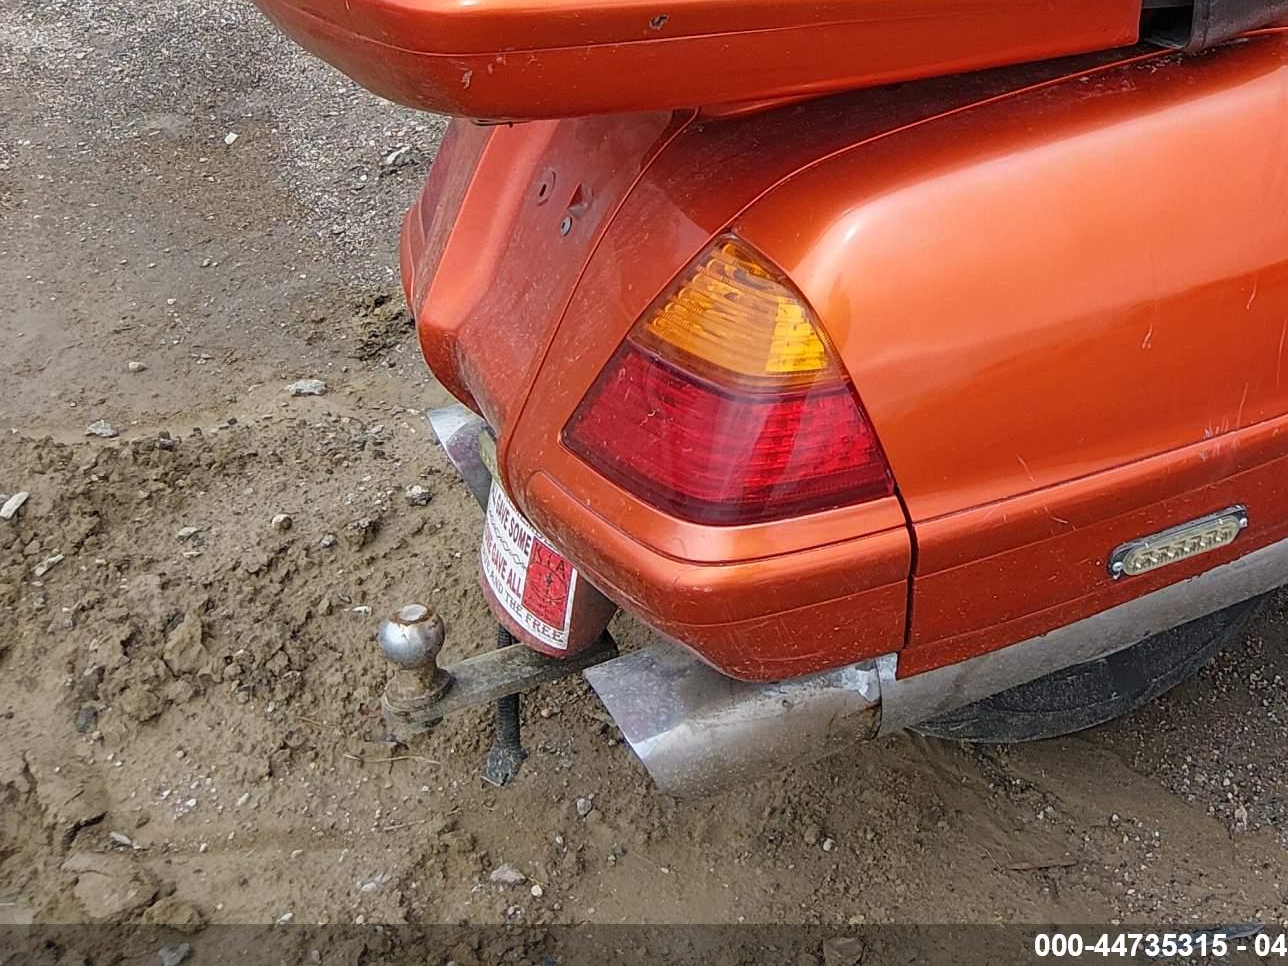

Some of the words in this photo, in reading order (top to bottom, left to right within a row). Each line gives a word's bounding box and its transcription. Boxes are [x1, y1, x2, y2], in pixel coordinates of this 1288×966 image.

[496, 494, 510, 530] GAVE
[509, 517, 531, 556] SOME
[492, 543, 507, 580] GAVE
[507, 568, 521, 599] ALL
[505, 590, 523, 618] THE
